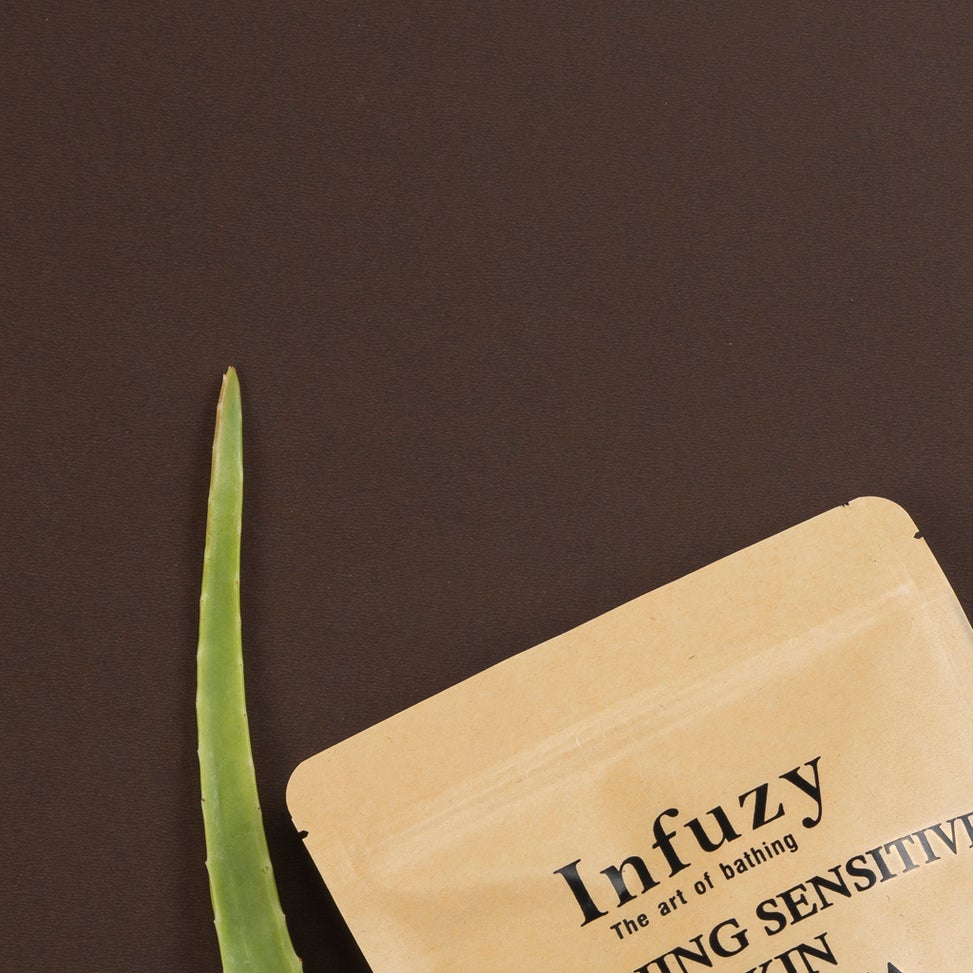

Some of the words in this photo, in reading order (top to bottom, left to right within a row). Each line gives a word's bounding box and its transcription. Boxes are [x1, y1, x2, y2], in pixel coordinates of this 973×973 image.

[554, 756, 827, 927] Infuzy
[610, 913, 649, 941] The
[658, 889, 688, 916] art
[694, 872, 715, 895] of
[719, 832, 799, 880] bathing
